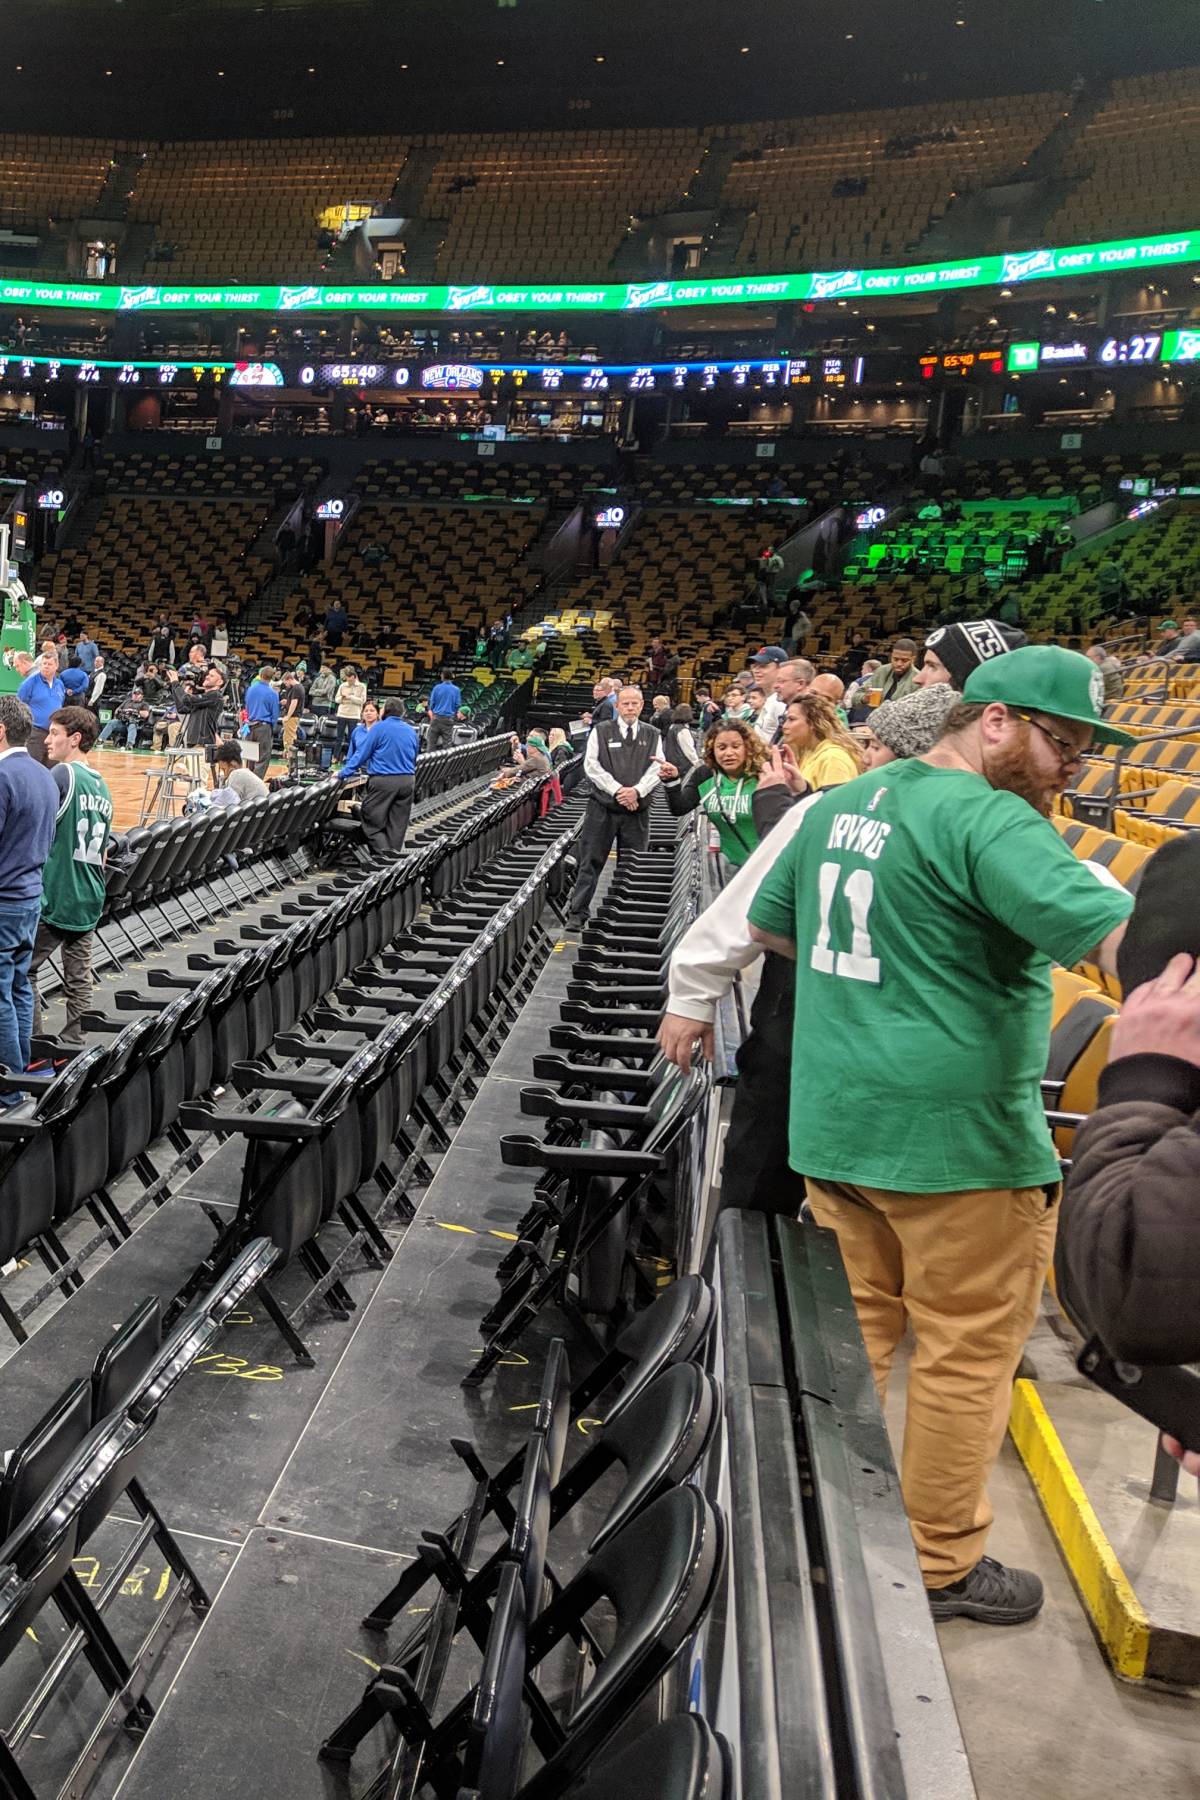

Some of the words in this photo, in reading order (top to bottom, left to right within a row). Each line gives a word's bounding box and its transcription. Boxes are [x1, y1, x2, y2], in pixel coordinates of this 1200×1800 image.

[1059, 252, 1094, 268] OBEY
[1099, 247, 1136, 262] YOUR
[1140, 240, 1190, 258] THIRST
[1004, 253, 1051, 281] Sprite
[815, 271, 857, 297] Sprite
[865, 276, 900, 289] OBEY
[903, 272, 936, 286] YOUR
[939, 266, 981, 281] THIRST
[4, 287, 33, 297] OBEY
[35, 289, 63, 300] YOUR
[66, 290, 102, 301] THIRST
[123, 289, 156, 308] Sprite
[163, 293, 191, 303] OBEY
[194, 293, 222, 303] YOUR
[224, 293, 260, 303] THIRST
[283, 288, 319, 308] Sprite
[325, 292, 354, 303] OBEY
[357, 292, 387, 303] YOUR
[390, 292, 428, 303] THIRST
[450, 288, 490, 308] Sprite
[497, 292, 527, 303] OBEY
[531, 292, 562, 303] YOUR
[565, 292, 605, 303] THIRST
[629, 283, 668, 307] Sprite
[675, 287, 706, 298] OBEY
[711, 284, 743, 296] YOUR
[746, 281, 789, 294] THIRST
[1041, 343, 1087, 362] Bank
[1101, 336, 1161, 362] 6:27
[301, 368, 314, 384] 0
[332, 365, 376, 378] 65:40
[396, 368, 409, 384] 0
[424, 368, 445, 381] NEW
[446, 365, 482, 382] ORLEANS
[47, 491, 63, 504] 10
[326, 500, 343, 514] 10
[607, 507, 624, 521] 10
[72, 817, 106, 865] 12
[811, 861, 881, 984] 11
[192, 1353, 284, 1381] 13B
